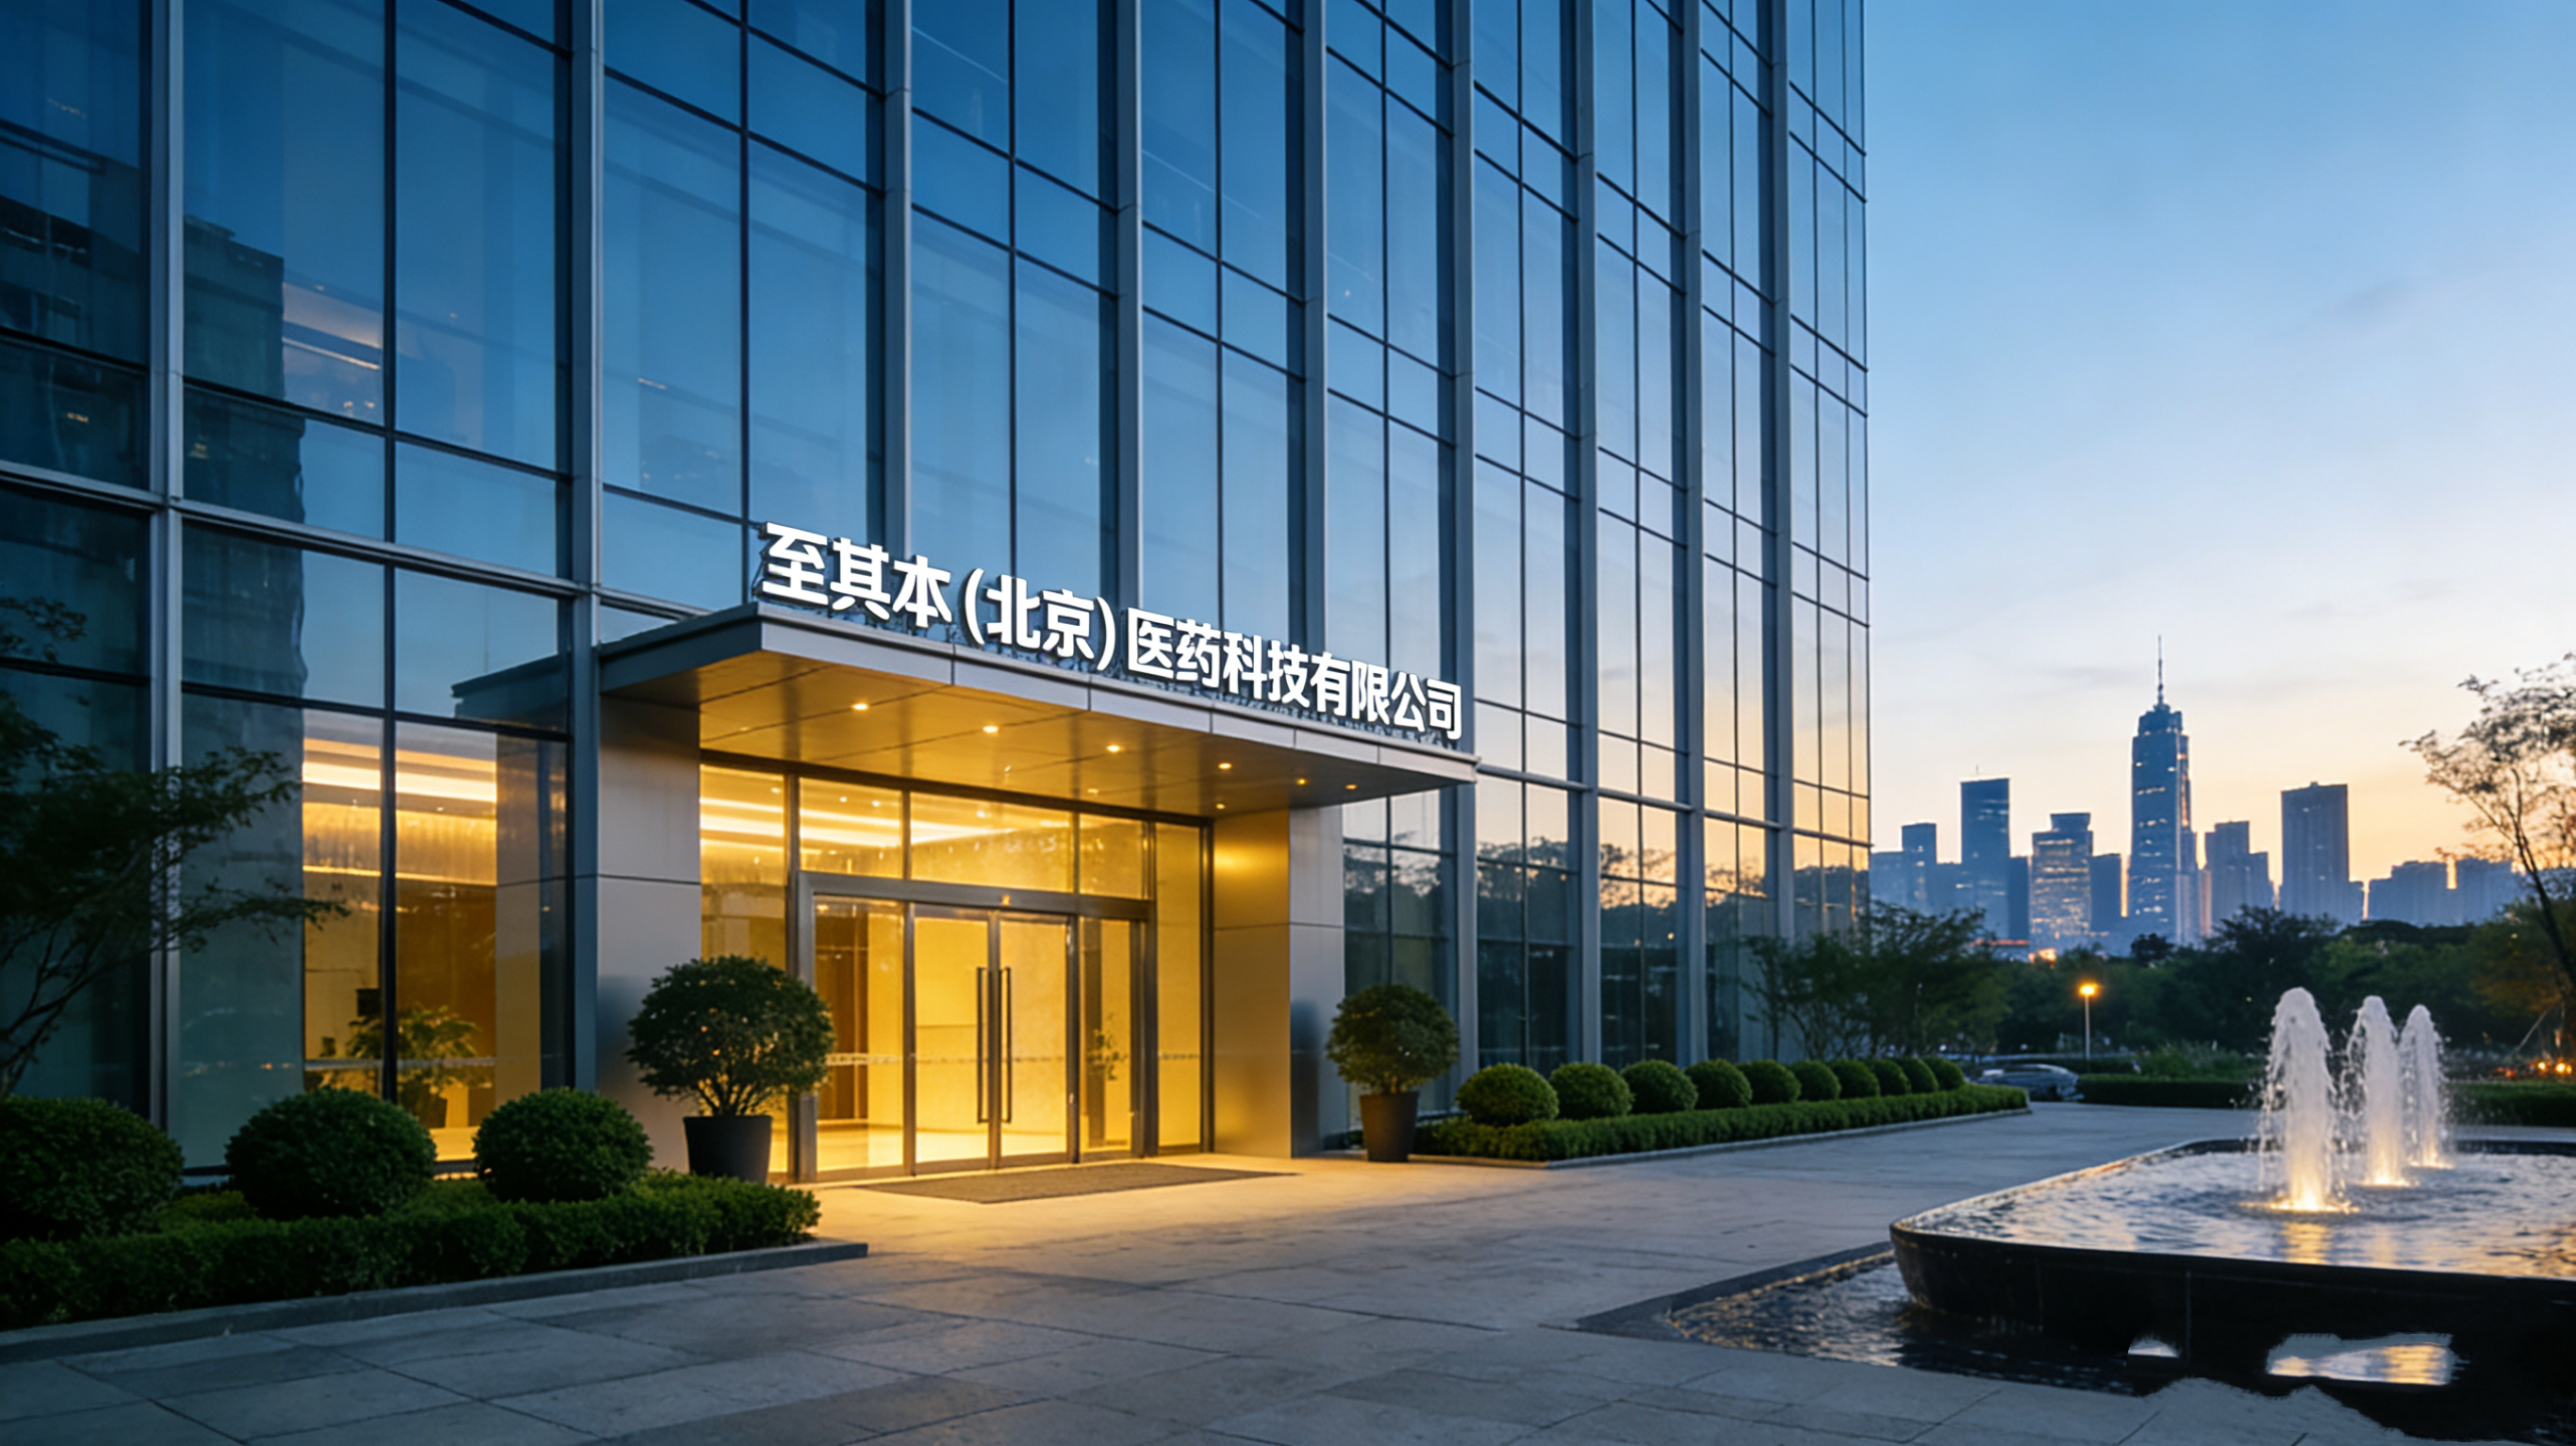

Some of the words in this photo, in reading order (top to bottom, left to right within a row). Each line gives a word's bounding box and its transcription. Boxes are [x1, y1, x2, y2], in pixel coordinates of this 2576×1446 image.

[761, 521, 1462, 740] 至其本（北京）医药科技有限公司
